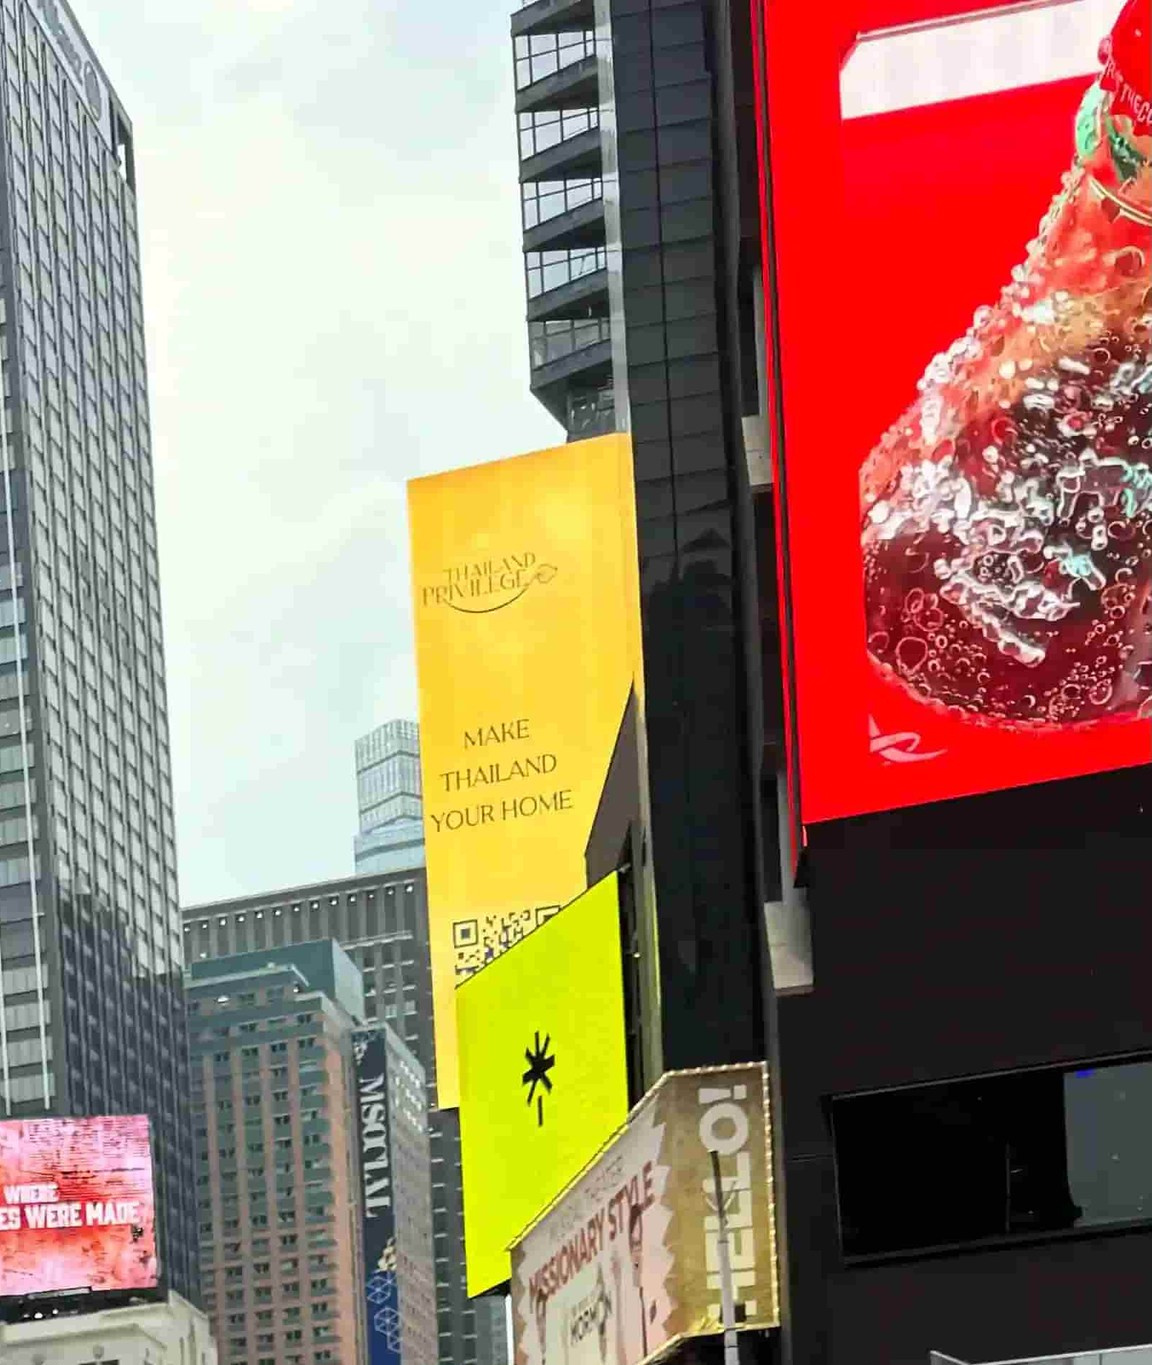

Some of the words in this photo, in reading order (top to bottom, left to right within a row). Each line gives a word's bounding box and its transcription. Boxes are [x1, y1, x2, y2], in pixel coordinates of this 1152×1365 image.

[442, 552, 537, 583] THAILAND
[421, 568, 531, 607] PRIVILEGE
[463, 718, 531, 750] MAKE
[438, 753, 558, 793] THAILAND
[429, 804, 496, 834] YOUR
[501, 789, 574, 821] HOME
[3, 1182, 61, 1205] WHERE
[23, 1201, 83, 1230] WERE
[86, 1201, 142, 1227] MADE
[528, 1207, 606, 1315] MISSIONARY
[607, 1160, 656, 1242] STYLE
